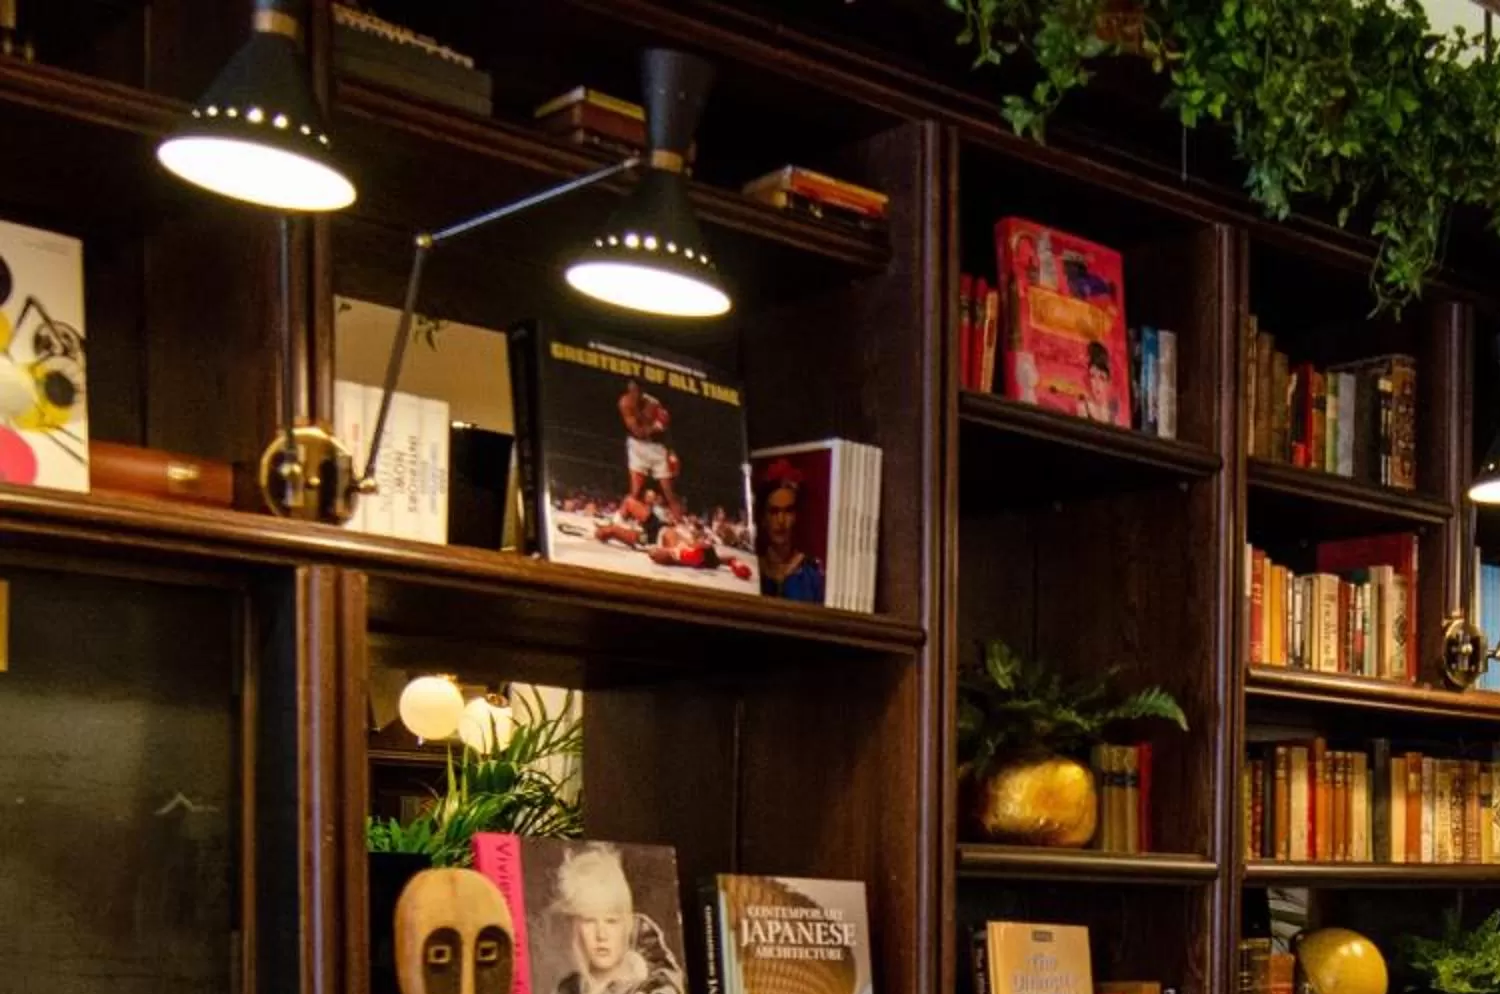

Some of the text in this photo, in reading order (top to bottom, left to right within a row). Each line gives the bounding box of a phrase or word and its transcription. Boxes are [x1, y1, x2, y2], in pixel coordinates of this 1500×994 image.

[551, 340, 642, 377] GREATEST
[643, 368, 667, 384] OF
[667, 372, 700, 395] ALL
[700, 380, 741, 407] TIME
[746, 905, 844, 921] CONTEMPORARY
[740, 918, 857, 947] JAPANESE
[754, 946, 845, 961] ARCHITECTURE
